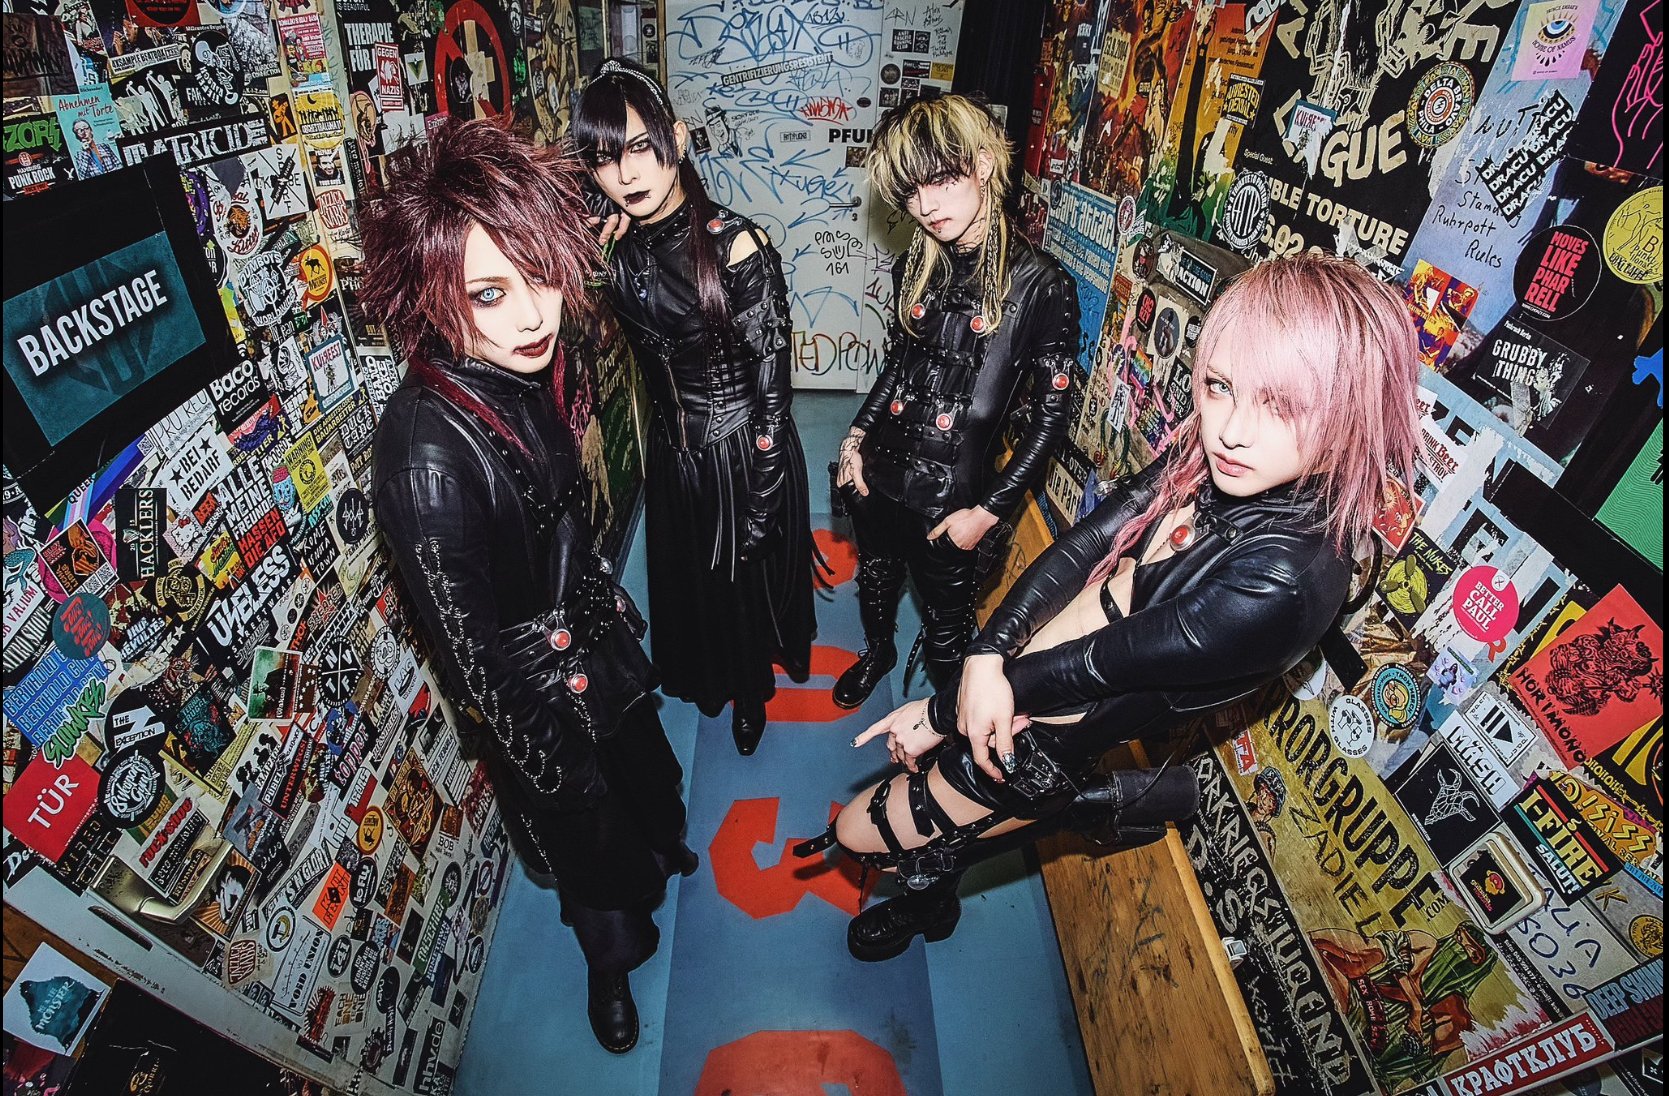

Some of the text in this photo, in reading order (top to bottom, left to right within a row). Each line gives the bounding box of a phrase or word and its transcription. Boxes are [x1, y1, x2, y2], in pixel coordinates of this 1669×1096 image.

[345, 23, 395, 45] THERAPIE
[350, 46, 373, 72] FÜR
[377, 47, 397, 58] GEGEN
[58, 96, 101, 112] Abnehmen
[381, 85, 400, 96] NAZIS
[1424, 79, 1455, 99] DELTA
[78, 104, 114, 118] mit Torte
[8, 171, 32, 190] PUNK
[31, 166, 56, 184] ROCK
[1307, 193, 1409, 255] TORTURE
[1432, 205, 1496, 237] Ruhrpott
[1465, 239, 1503, 270] Rules
[1550, 231, 1589, 256] MOVES
[1540, 245, 1582, 278] LIKE
[1177, 265, 1210, 297] ACTION
[1531, 268, 1571, 295] PHAR
[1524, 285, 1563, 313] RELL
[17, 270, 168, 377] BACKSTAGE
[1492, 339, 1548, 367] GRUBBY
[208, 360, 254, 401] Baco
[218, 375, 261, 416] records
[316, 401, 357, 443] BAUARBEITER
[179, 446, 201, 474] BEI
[1436, 443, 1459, 471] Beer
[180, 449, 221, 501] BEDARF
[214, 455, 264, 508] ALLE
[226, 478, 273, 527] MEINE
[233, 496, 276, 540] FREUNDE
[138, 489, 155, 579] HACKLERS
[238, 507, 282, 554] HASSEN
[244, 542, 263, 569] DIE
[264, 521, 287, 550] AFD
[1411, 532, 1430, 551] THE
[313, 546, 336, 578] TOWN
[1425, 548, 1454, 577] NUKES
[7, 585, 38, 623] VALIUM
[1468, 589, 1499, 620] CALL
[1475, 582, 1505, 612] BETTER
[1462, 599, 1491, 631] PAUL
[3, 655, 59, 717] BERTHOLD
[16, 668, 72, 732] BERTHOLD
[114, 715, 130, 726] THE
[1345, 698, 1372, 734] GLASSES
[1516, 667, 1587, 764] HORIMONO
[115, 727, 156, 746] EXCEPTION
[1333, 735, 1368, 756] GLASSES
[27, 774, 80, 829] TÜR
[1535, 843, 1583, 895] SALUT!
[1585, 982, 1630, 1021] DEEP
